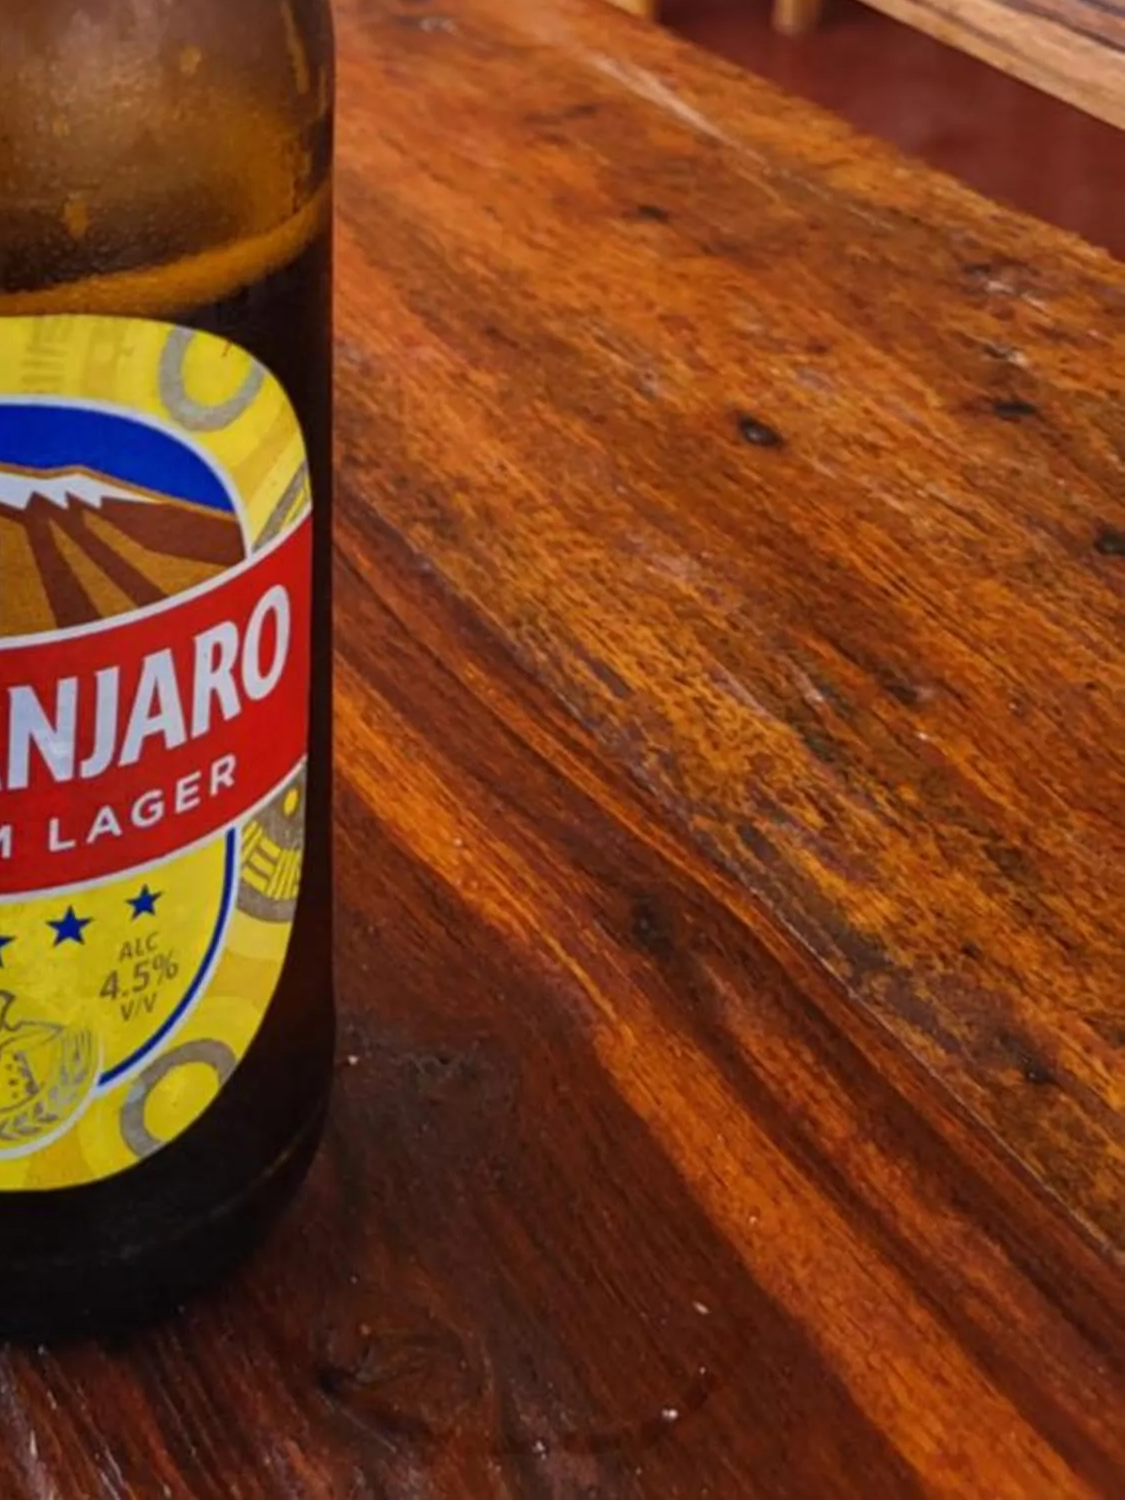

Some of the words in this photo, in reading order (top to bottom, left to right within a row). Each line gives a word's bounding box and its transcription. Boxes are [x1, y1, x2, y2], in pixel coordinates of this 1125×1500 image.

[48, 754, 236, 854] LAGER
[98, 946, 179, 1001] 4.5%
[118, 931, 159, 963] ALC
